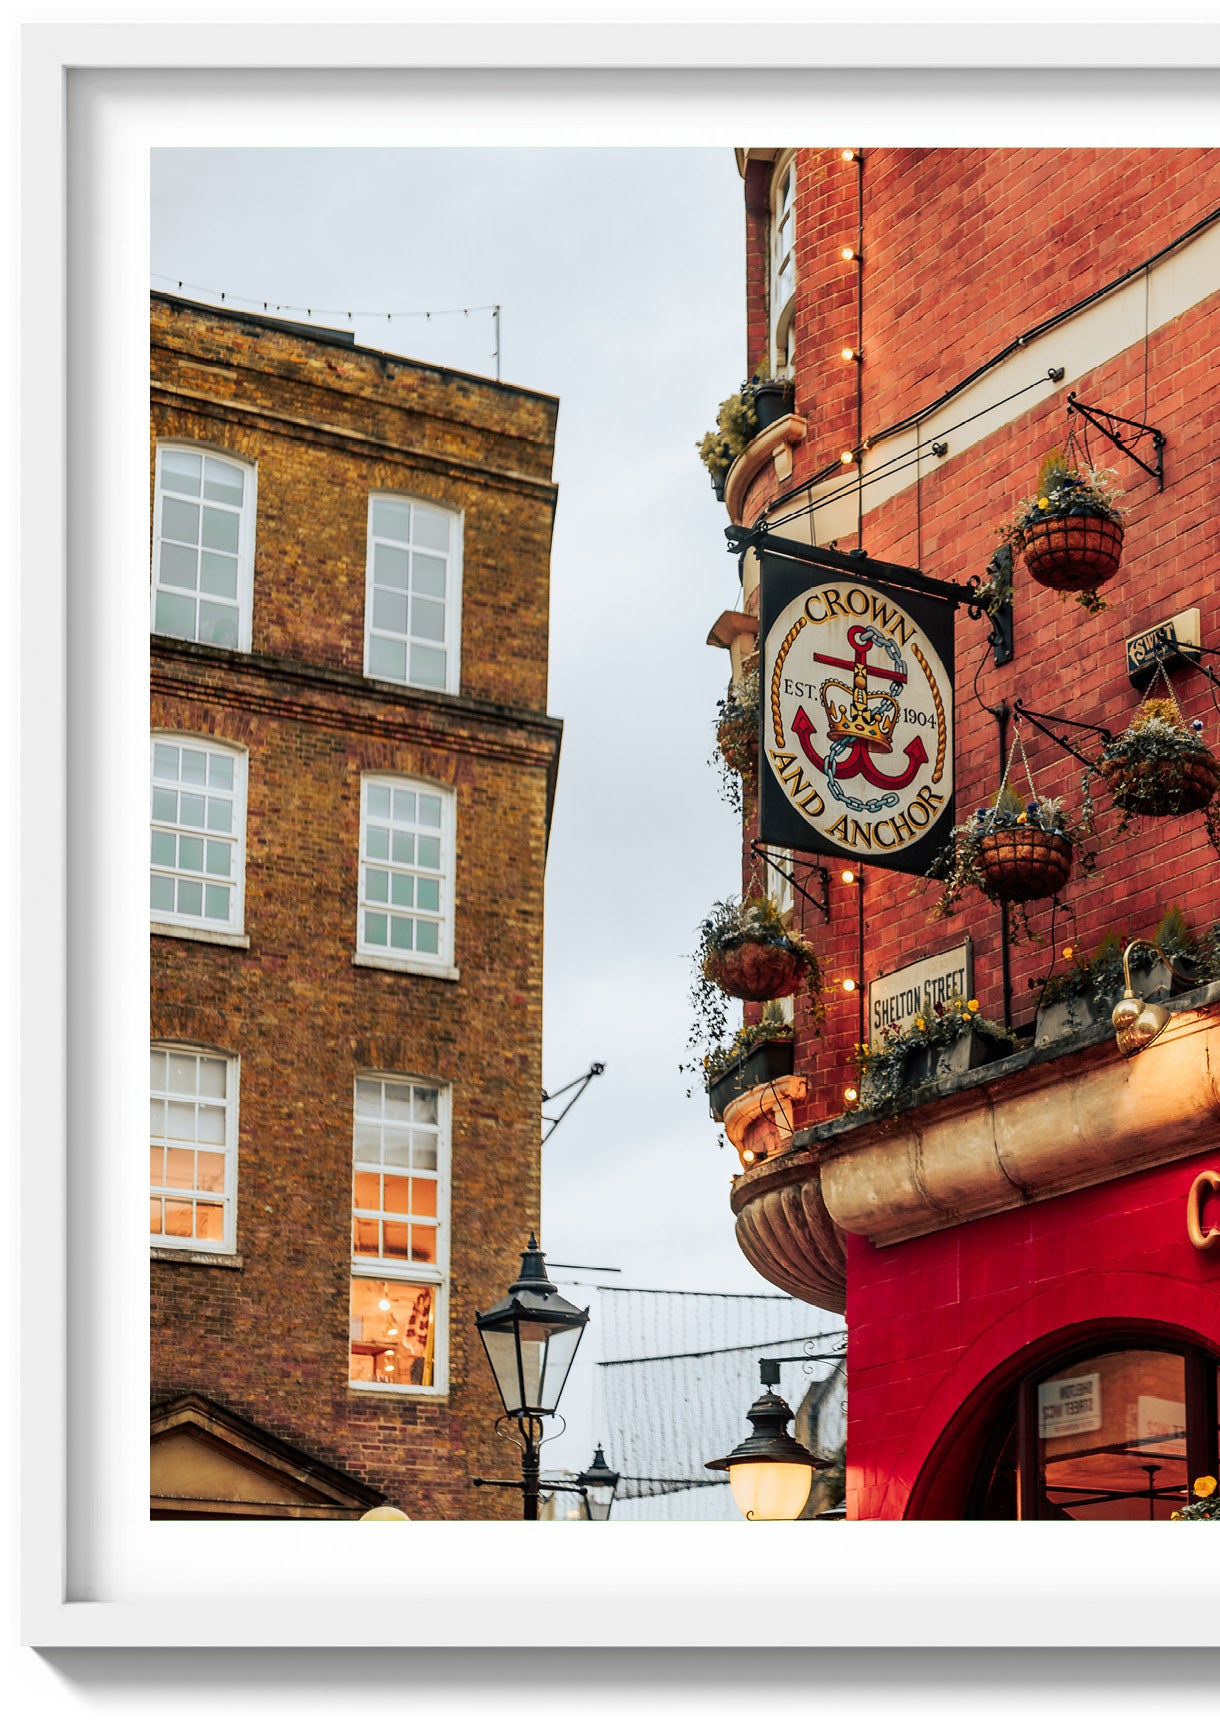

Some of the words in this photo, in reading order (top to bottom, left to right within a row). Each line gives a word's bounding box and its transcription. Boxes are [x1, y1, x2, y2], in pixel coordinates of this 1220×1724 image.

[804, 588, 917, 648] CROWN
[784, 678, 818, 702] EST.
[903, 708, 937, 730] 1904
[768, 748, 826, 818] AND
[825, 784, 945, 850] ANCHOR
[874, 986, 921, 1030] SHELTON
[924, 967, 965, 1007] STREET
